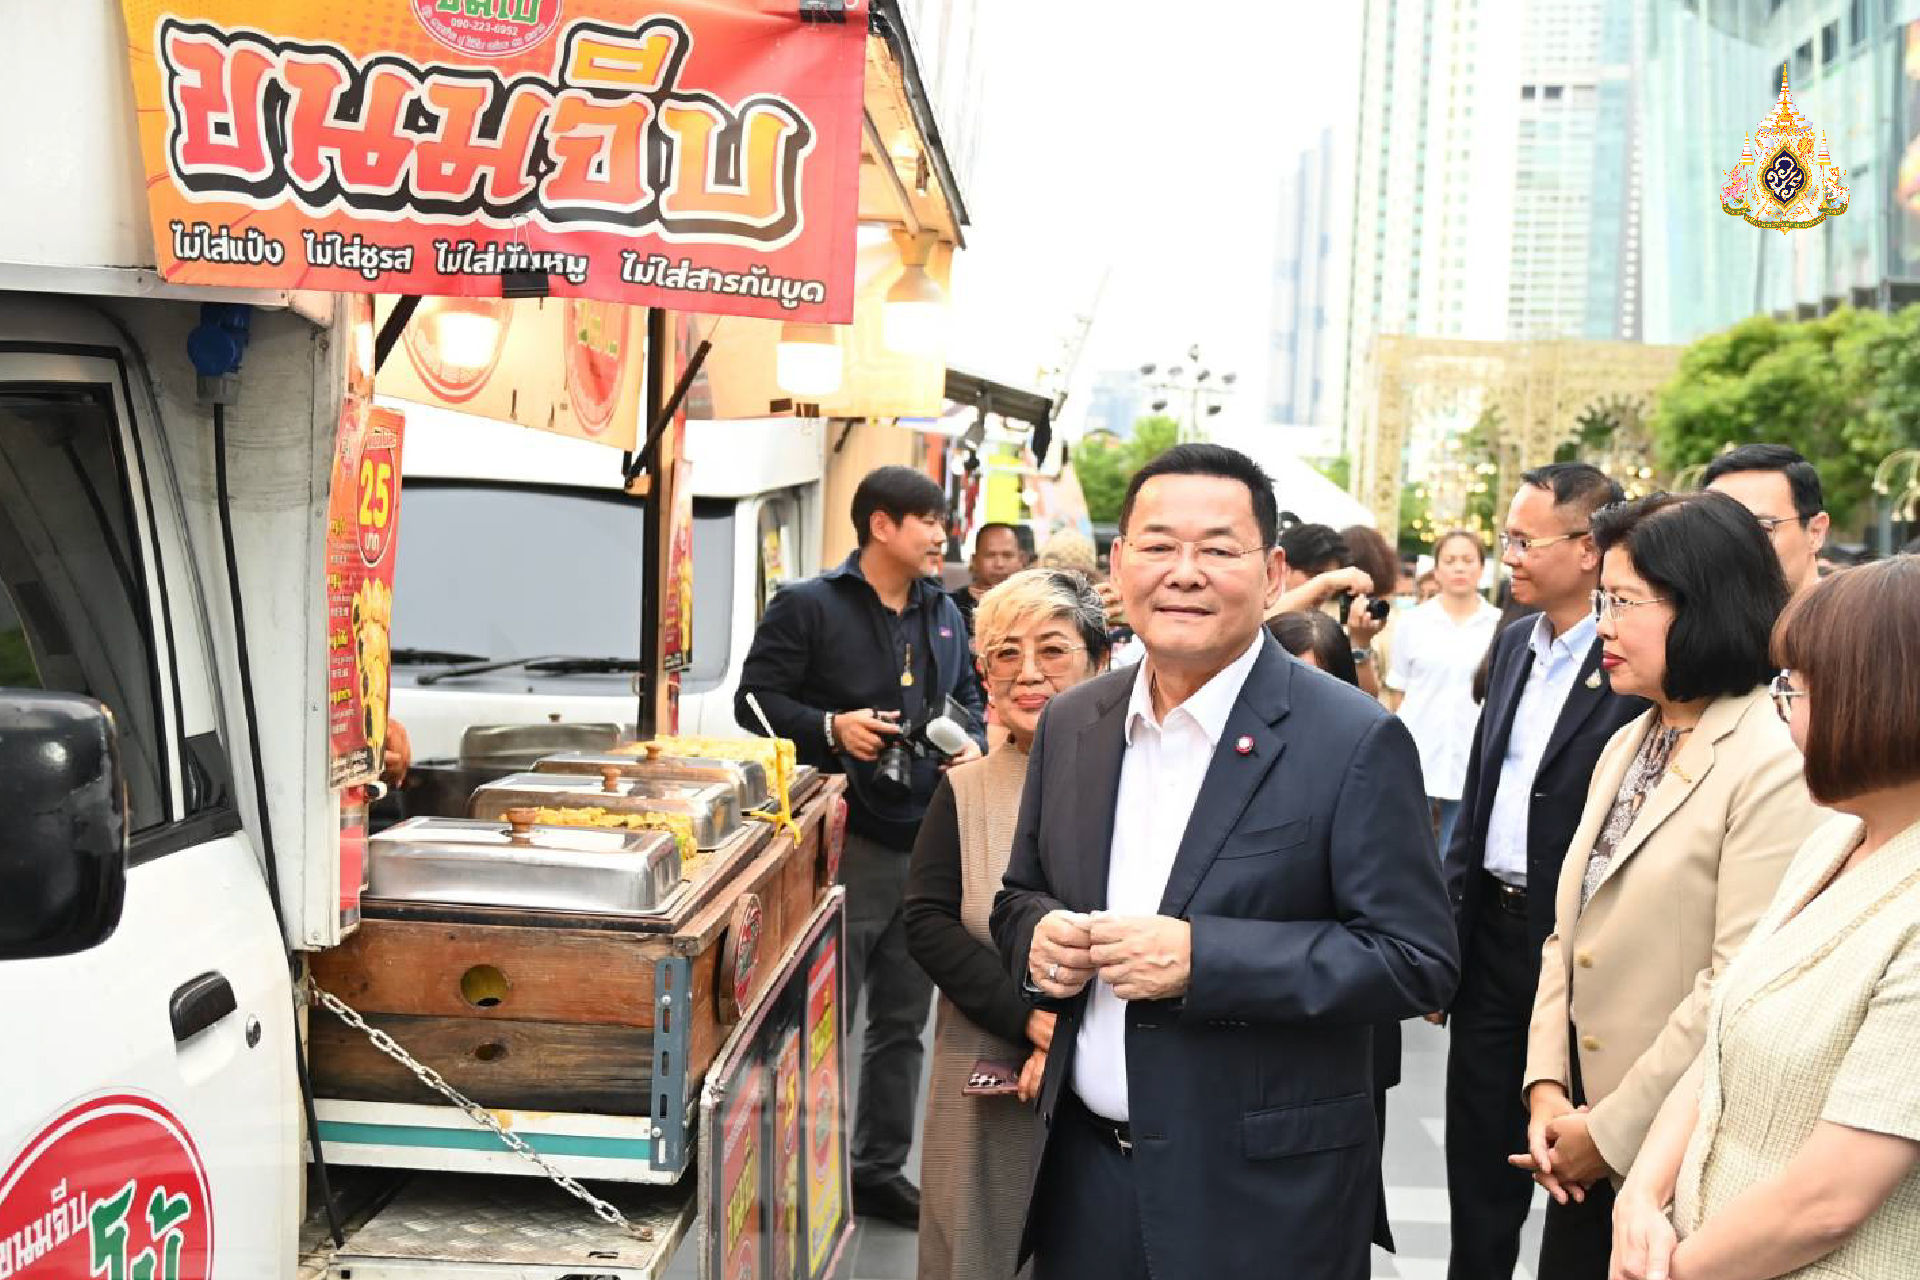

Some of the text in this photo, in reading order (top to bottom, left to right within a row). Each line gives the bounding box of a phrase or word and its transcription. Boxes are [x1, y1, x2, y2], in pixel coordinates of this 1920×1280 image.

[163, 22, 812, 244] ขนมจีบ
[170, 220, 284, 266] ไม่ใส่แป้ง
[302, 230, 414, 280] ไม่ใส่ชูรส
[621, 250, 826, 308] ไม่ใส่สารกันบูด
[359, 458, 391, 529] 25
